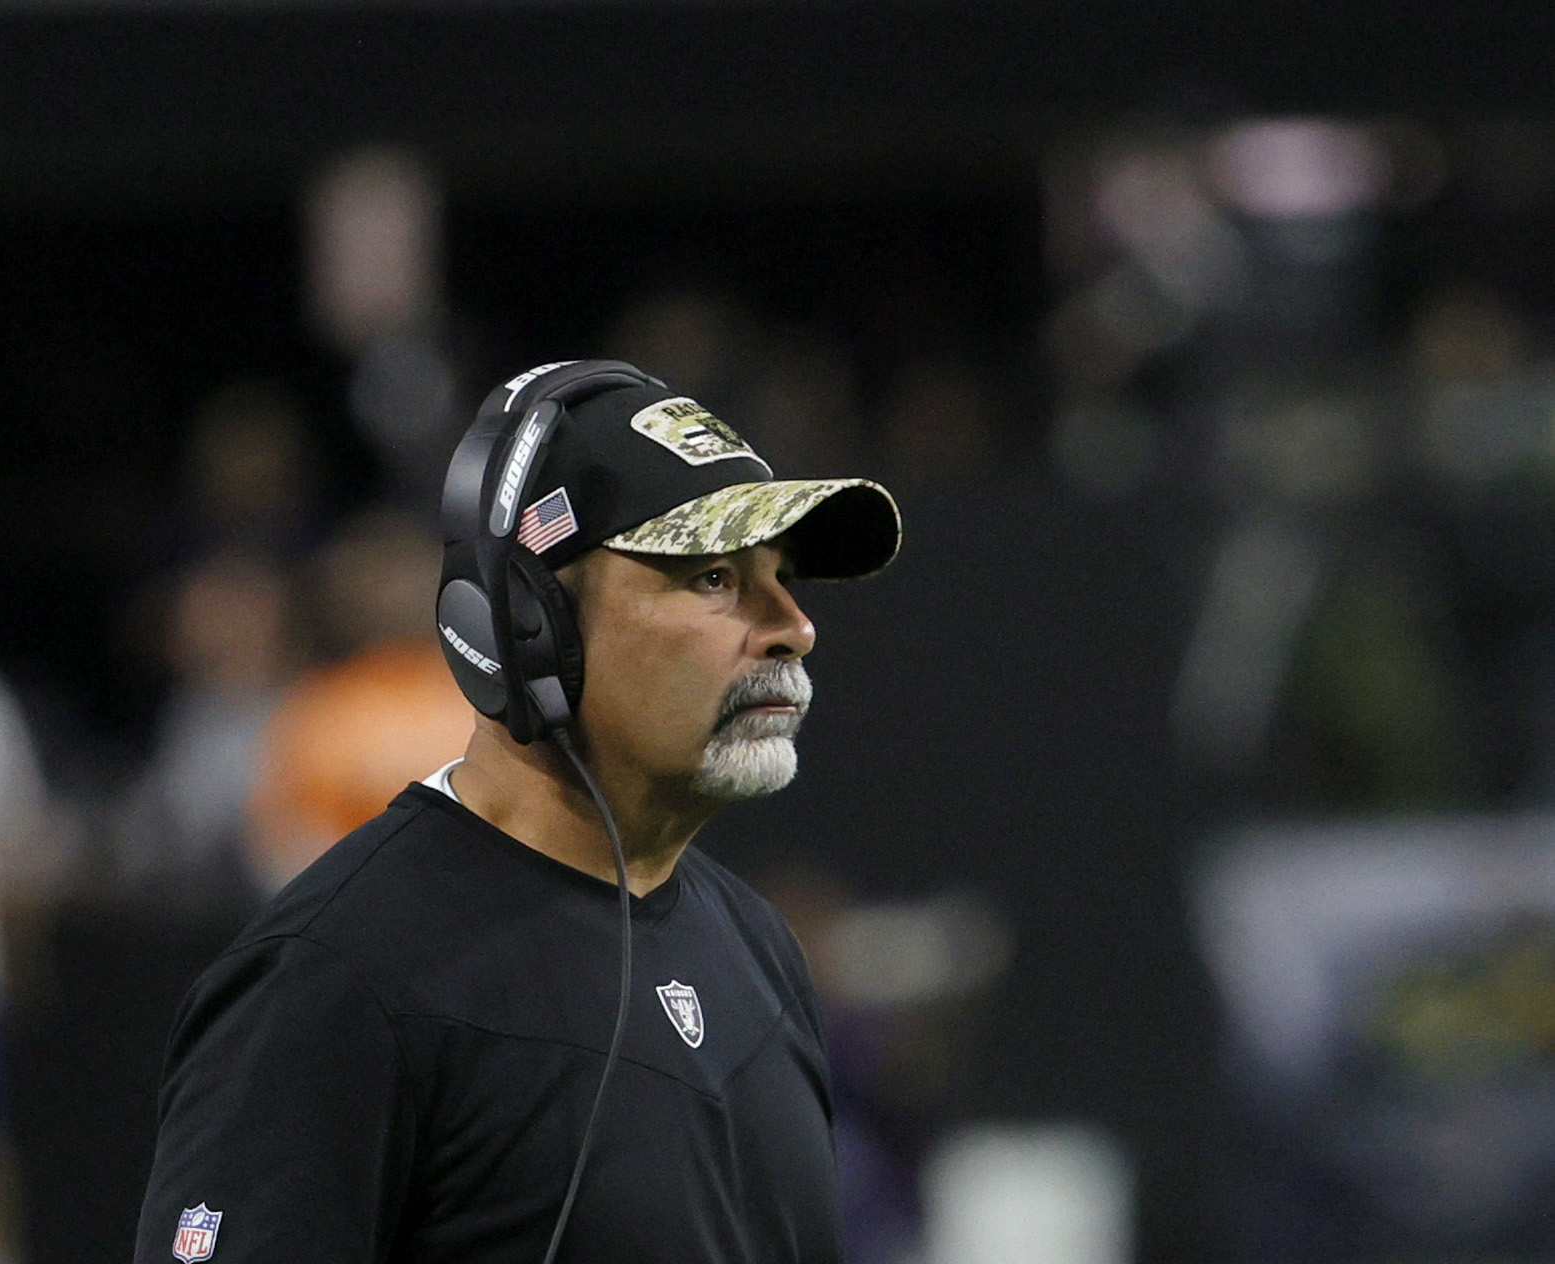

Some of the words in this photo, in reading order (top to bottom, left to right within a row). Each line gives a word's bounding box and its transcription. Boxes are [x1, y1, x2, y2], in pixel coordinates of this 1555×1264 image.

[499, 411, 541, 529] BOSE
[438, 622, 502, 675] BOSE
[176, 1229, 208, 1257] NFL
